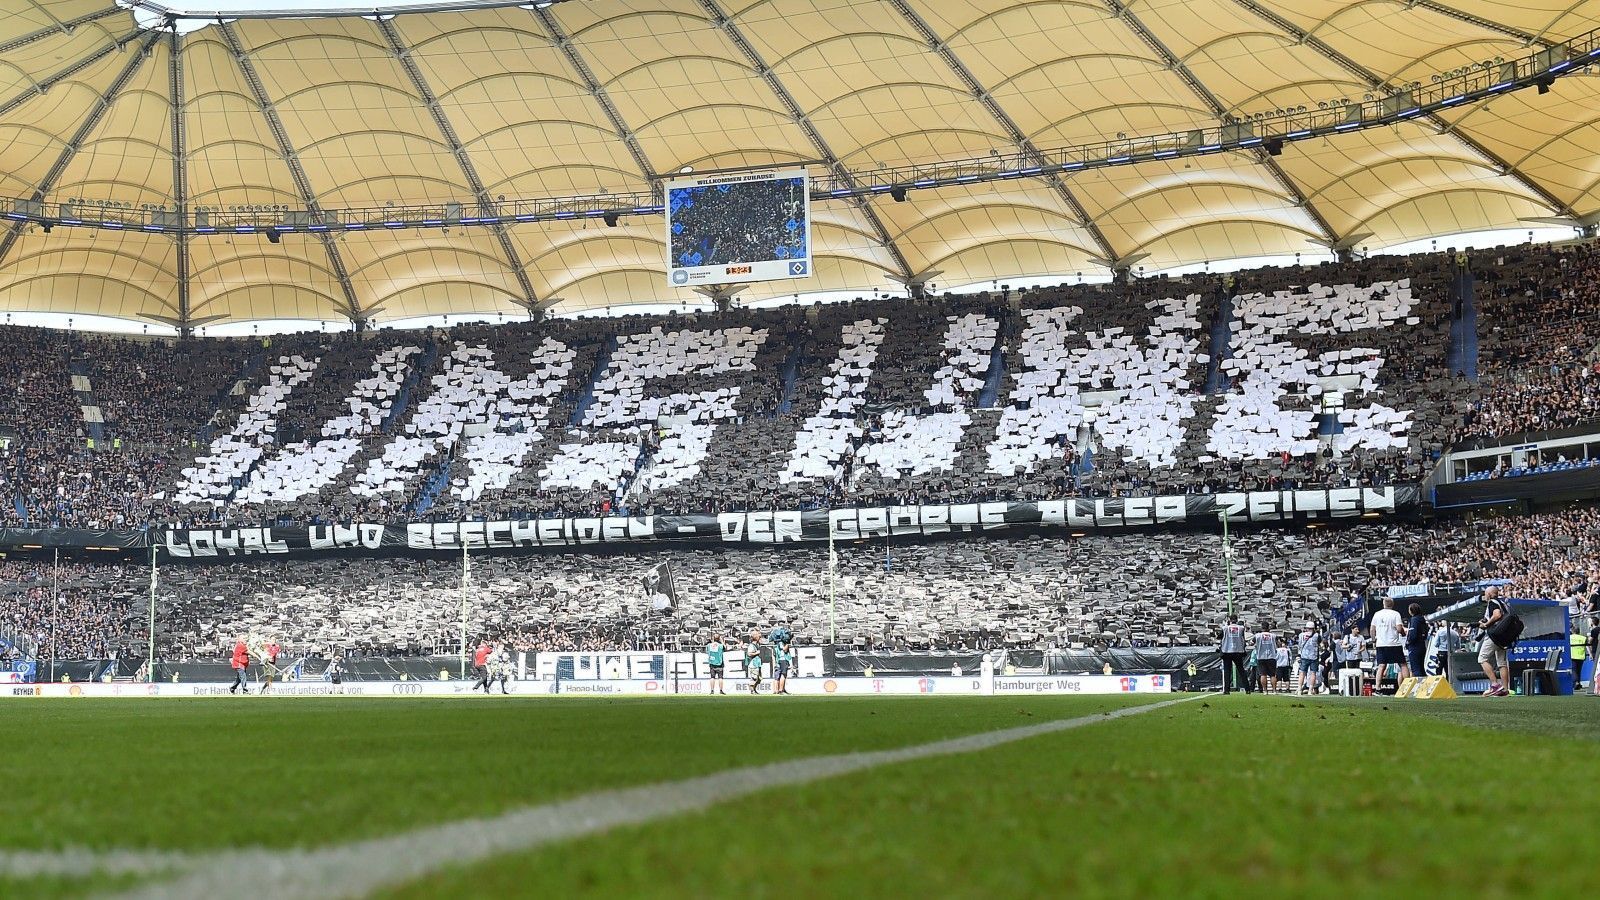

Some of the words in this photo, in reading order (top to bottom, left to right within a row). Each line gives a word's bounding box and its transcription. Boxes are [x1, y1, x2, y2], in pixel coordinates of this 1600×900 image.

[166, 528, 289, 557] LOYAL
[308, 523, 385, 549] UND
[407, 515, 654, 550] BESCHEIDEN
[717, 511, 802, 542] DER
[1038, 496, 1186, 527] ALLER
[1216, 486, 1395, 523] ZEITEN
[193, 686, 209, 695] Der
[994, 680, 1053, 691] Hamburger
[1057, 680, 1081, 692] Weg
